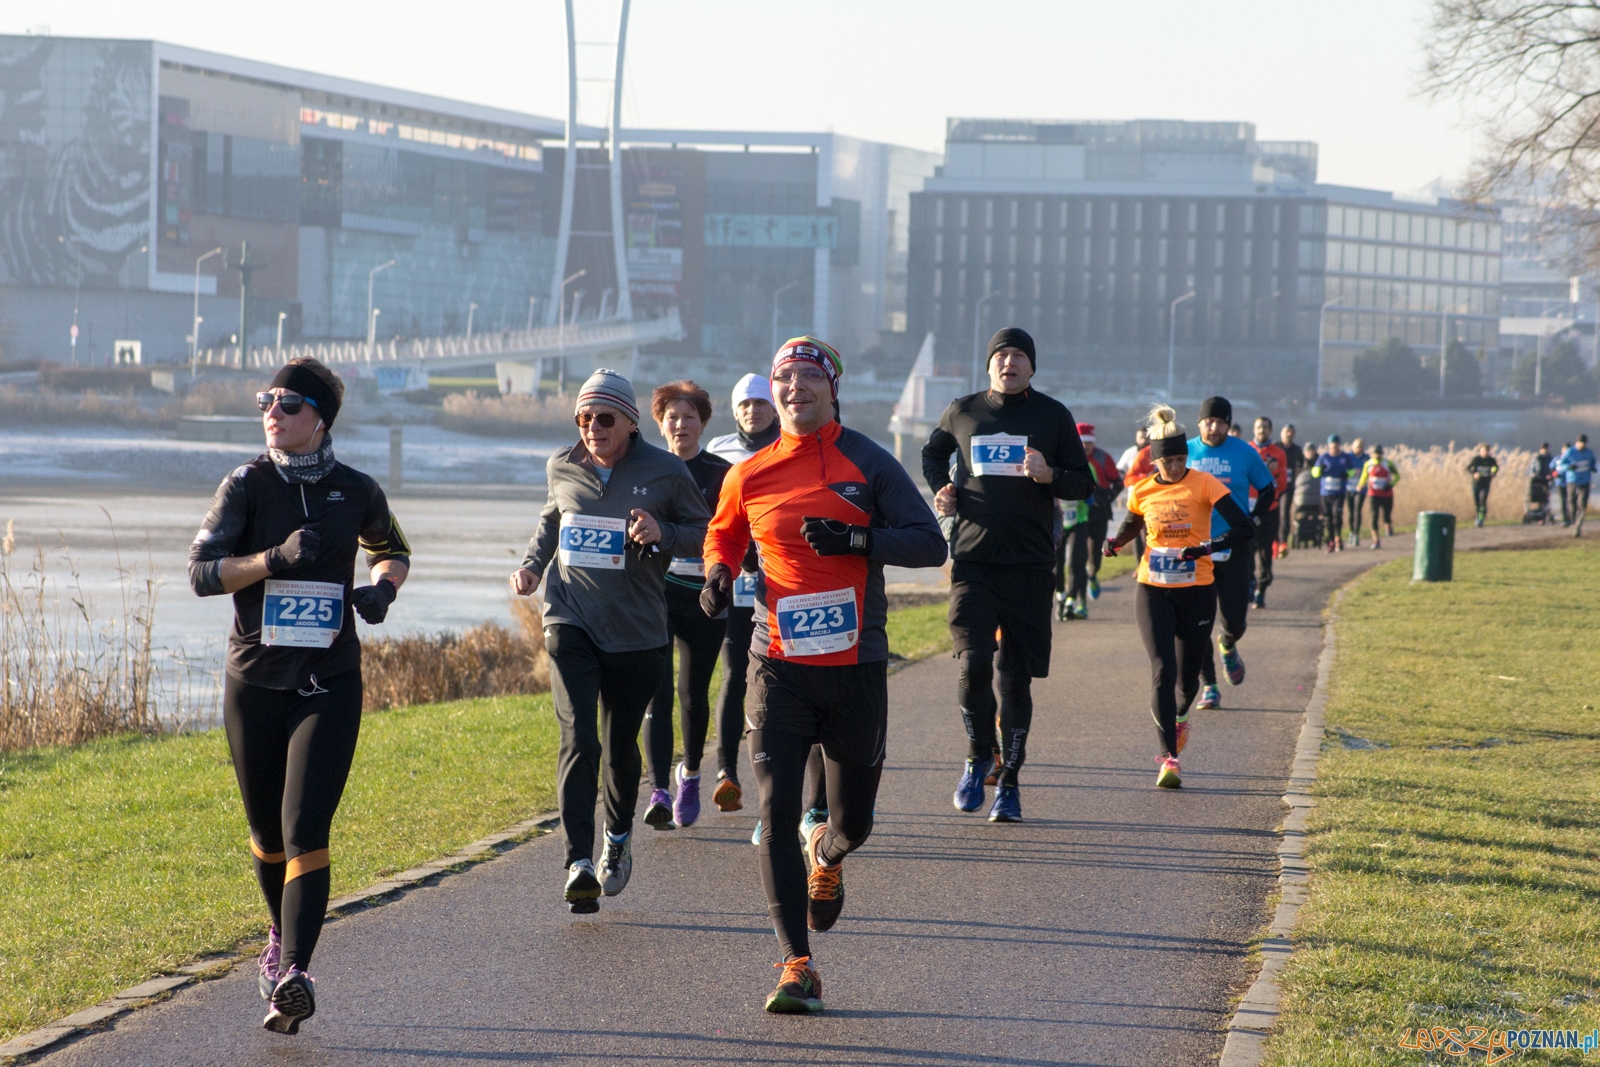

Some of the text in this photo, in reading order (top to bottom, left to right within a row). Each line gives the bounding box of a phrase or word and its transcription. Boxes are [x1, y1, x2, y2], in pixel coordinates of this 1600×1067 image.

[986, 445, 1010, 460] 75
[1201, 457, 1220, 465] BIEG
[569, 528, 612, 549] 322
[1156, 556, 1188, 570] 172
[812, 591, 851, 602] SYLWESTROWY
[823, 597, 849, 605] BURGIELA
[279, 597, 333, 622] 225
[792, 606, 845, 633] 223
[1005, 727, 1026, 770] Kalenji
